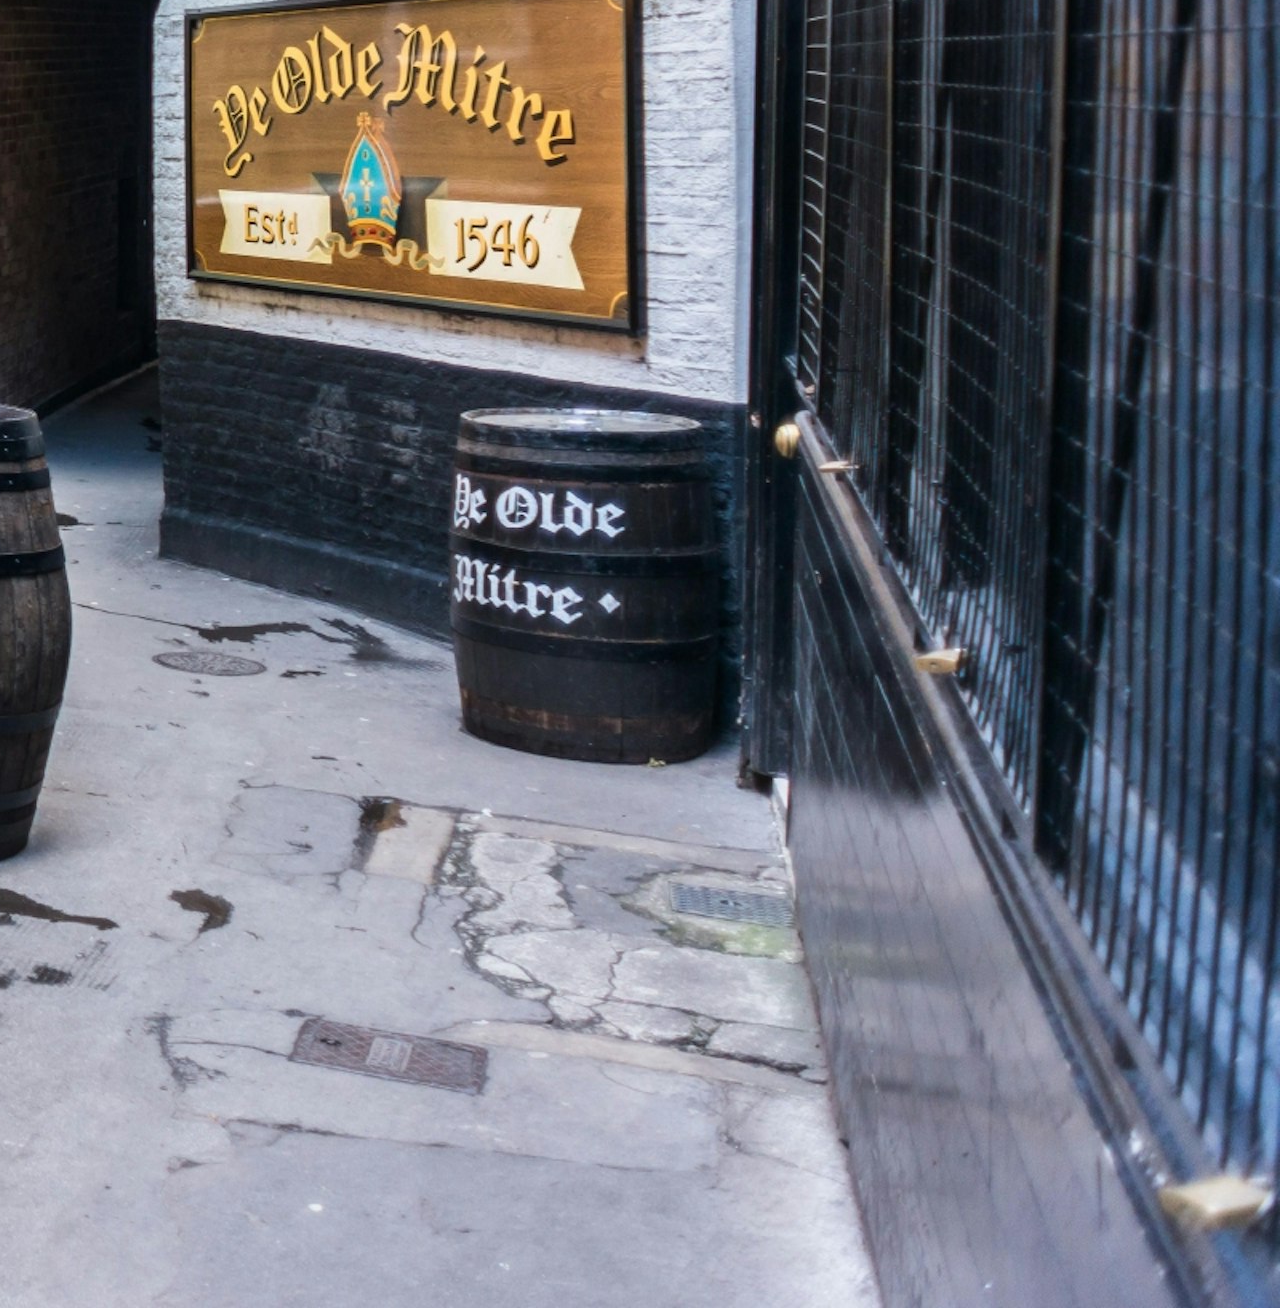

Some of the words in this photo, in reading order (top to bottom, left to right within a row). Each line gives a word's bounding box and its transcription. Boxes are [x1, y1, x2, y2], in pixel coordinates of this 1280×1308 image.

[212, 84, 273, 177] Ye
[272, 25, 383, 114] Olde
[383, 23, 576, 166] Mitre
[454, 214, 540, 272] 1546
[496, 486, 626, 538] Olde
[454, 553, 583, 624] Mitre
